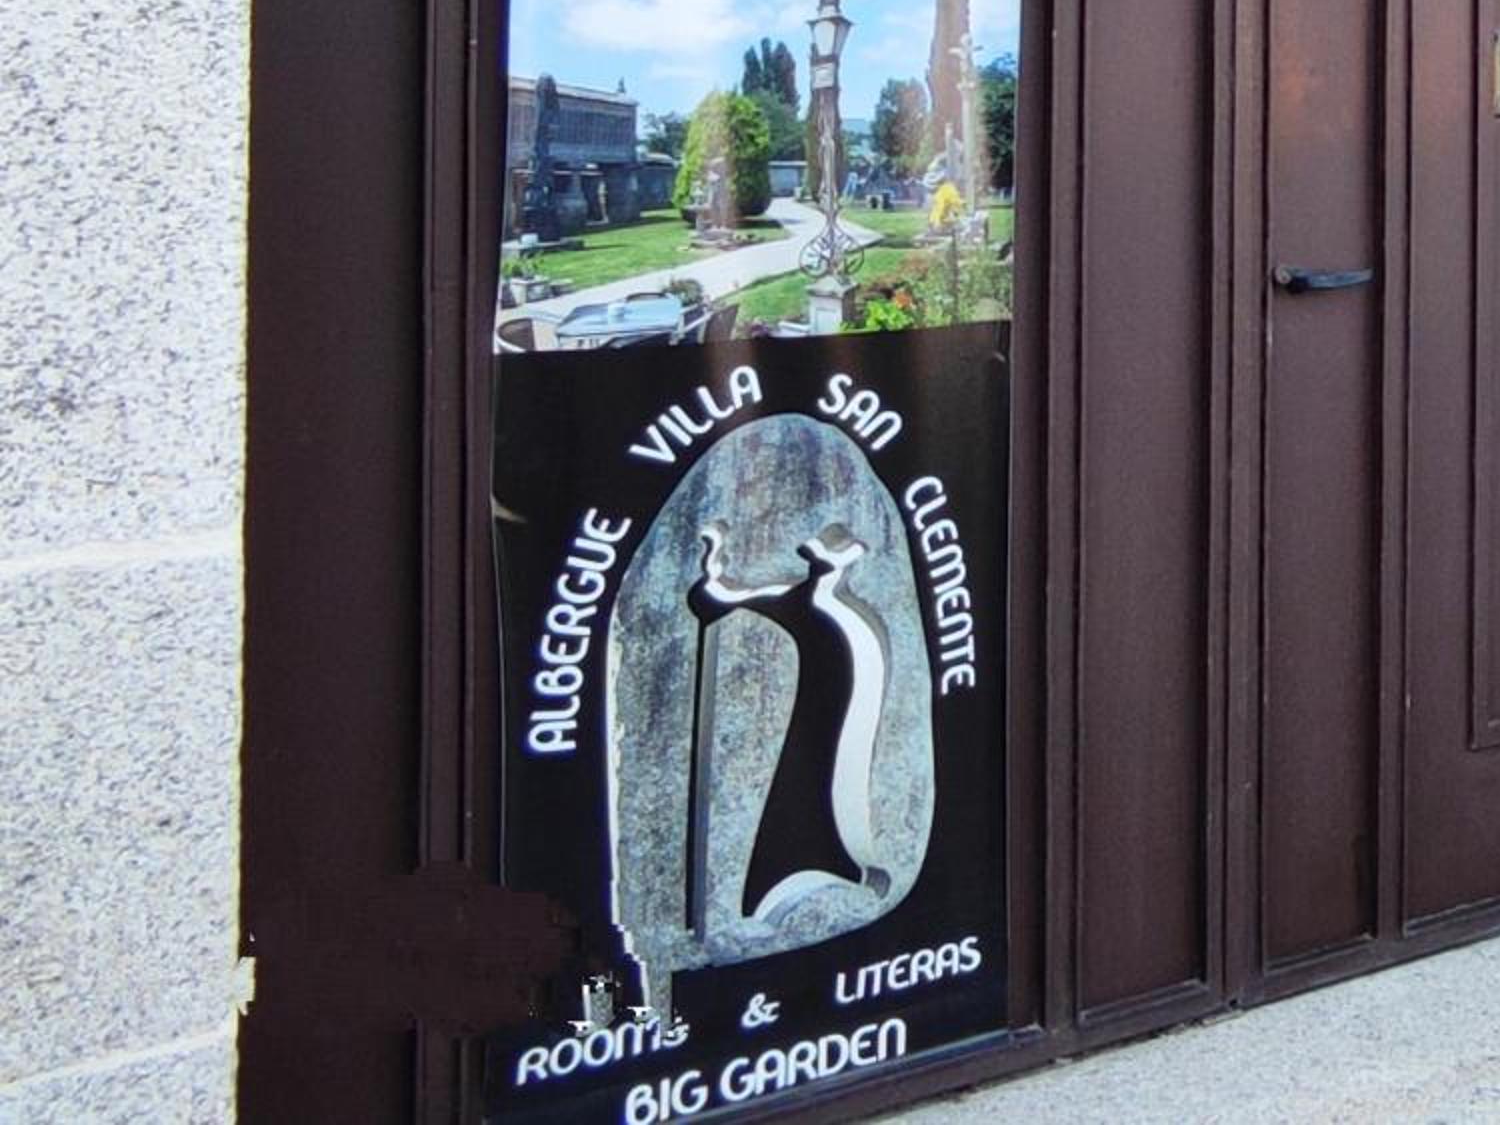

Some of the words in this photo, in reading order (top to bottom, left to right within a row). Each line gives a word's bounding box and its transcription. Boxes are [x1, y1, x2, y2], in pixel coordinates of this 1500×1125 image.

[527, 508, 632, 753] ALBERGUE
[629, 365, 763, 464] VILLA
[816, 373, 903, 452] SAN
[904, 476, 977, 695] CLEMENTE
[741, 993, 781, 1028] &
[834, 936, 982, 1005] LITERAS
[625, 1069, 708, 1125] BIG
[719, 1017, 907, 1101] GARDEN
